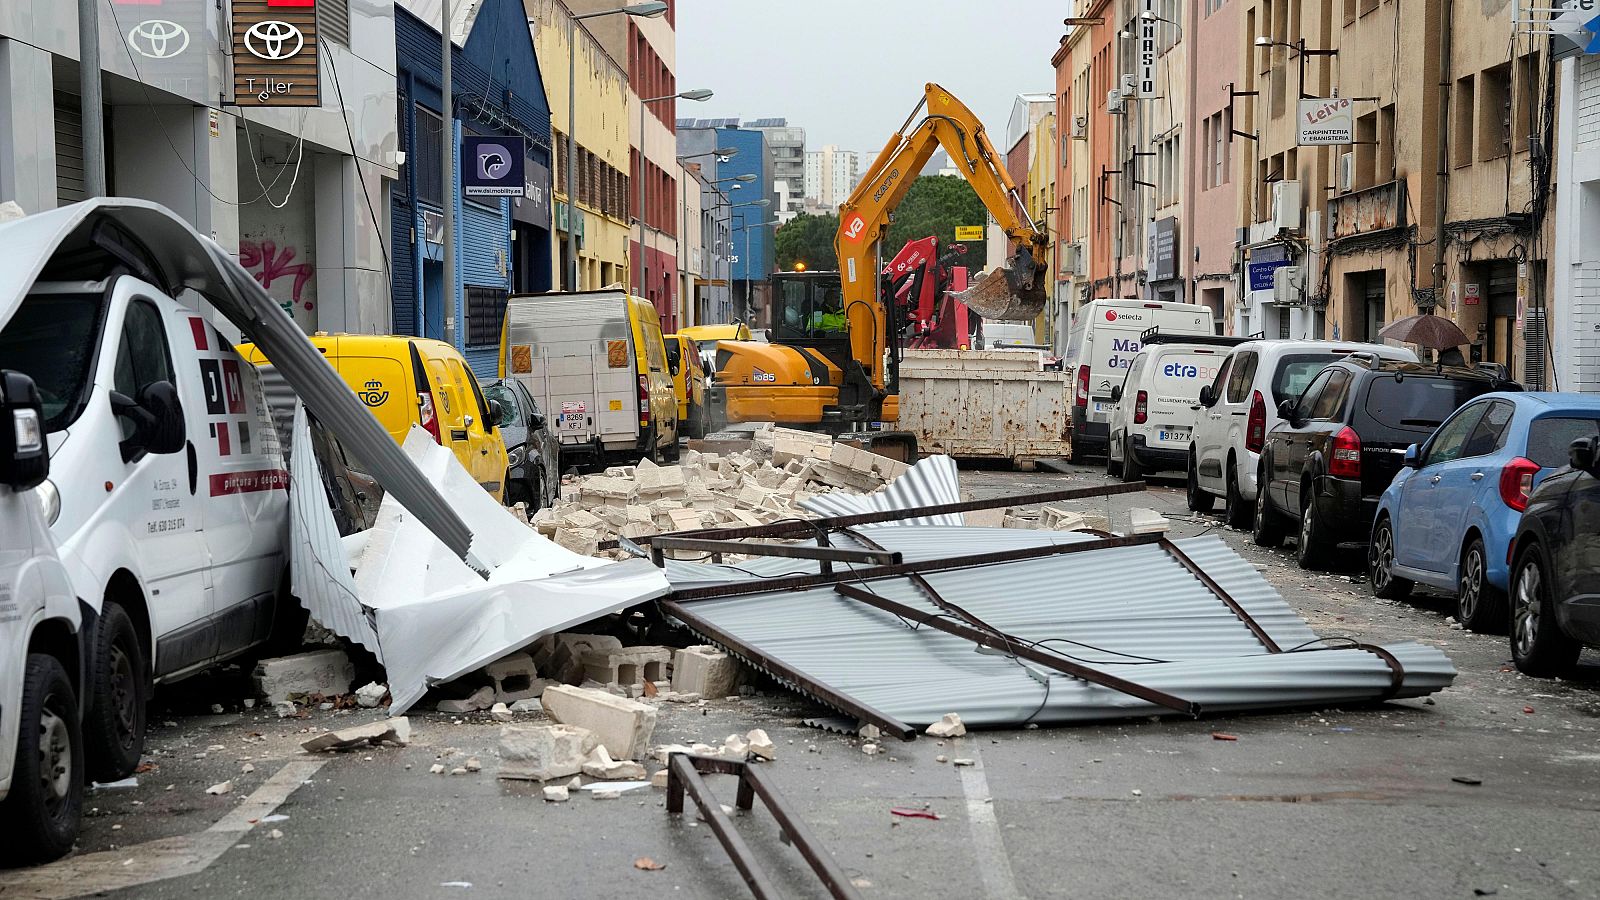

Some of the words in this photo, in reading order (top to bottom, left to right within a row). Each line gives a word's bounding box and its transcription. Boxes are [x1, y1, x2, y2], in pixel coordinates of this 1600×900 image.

[1306, 98, 1350, 125] Leiva
[873, 168, 900, 203] KATO
[1118, 313, 1142, 321] selecta
[1163, 362, 1197, 378] etra
[566, 413, 584, 421] 8269
[1164, 432, 1185, 441] 9137
[224, 477, 252, 490] pintura
[254, 475, 259, 488] y
